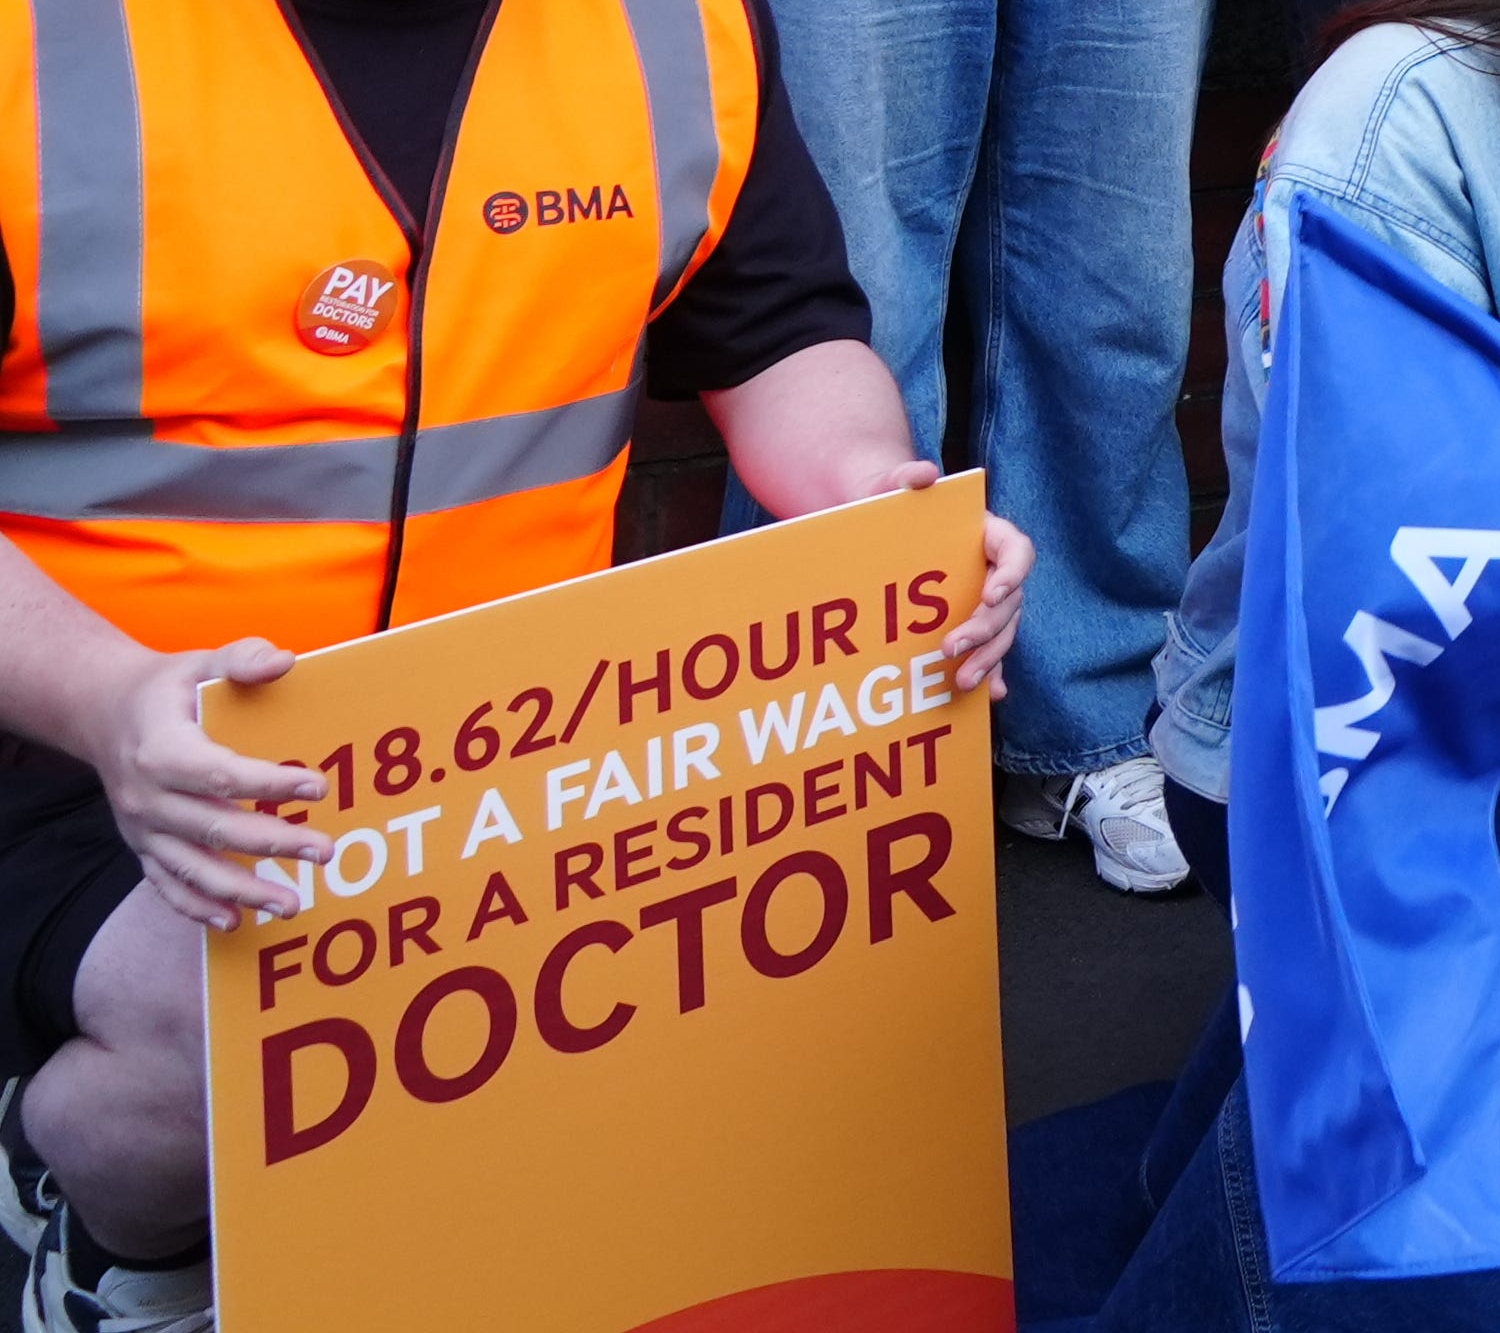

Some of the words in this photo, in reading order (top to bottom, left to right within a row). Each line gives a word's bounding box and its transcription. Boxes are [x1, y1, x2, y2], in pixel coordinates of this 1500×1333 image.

[536, 184, 634, 226] BMA
[312, 303, 376, 330] DOCTORS
[324, 267, 394, 307] PAY
[885, 570, 949, 643] IS
[462, 788, 522, 859] A
[547, 723, 720, 830] FAIR
[739, 650, 946, 765] WAGE
[258, 896, 442, 1012] FOR
[466, 871, 528, 942] A
[555, 724, 951, 911] RESIDENT
[262, 812, 956, 1166] DOCTOR
